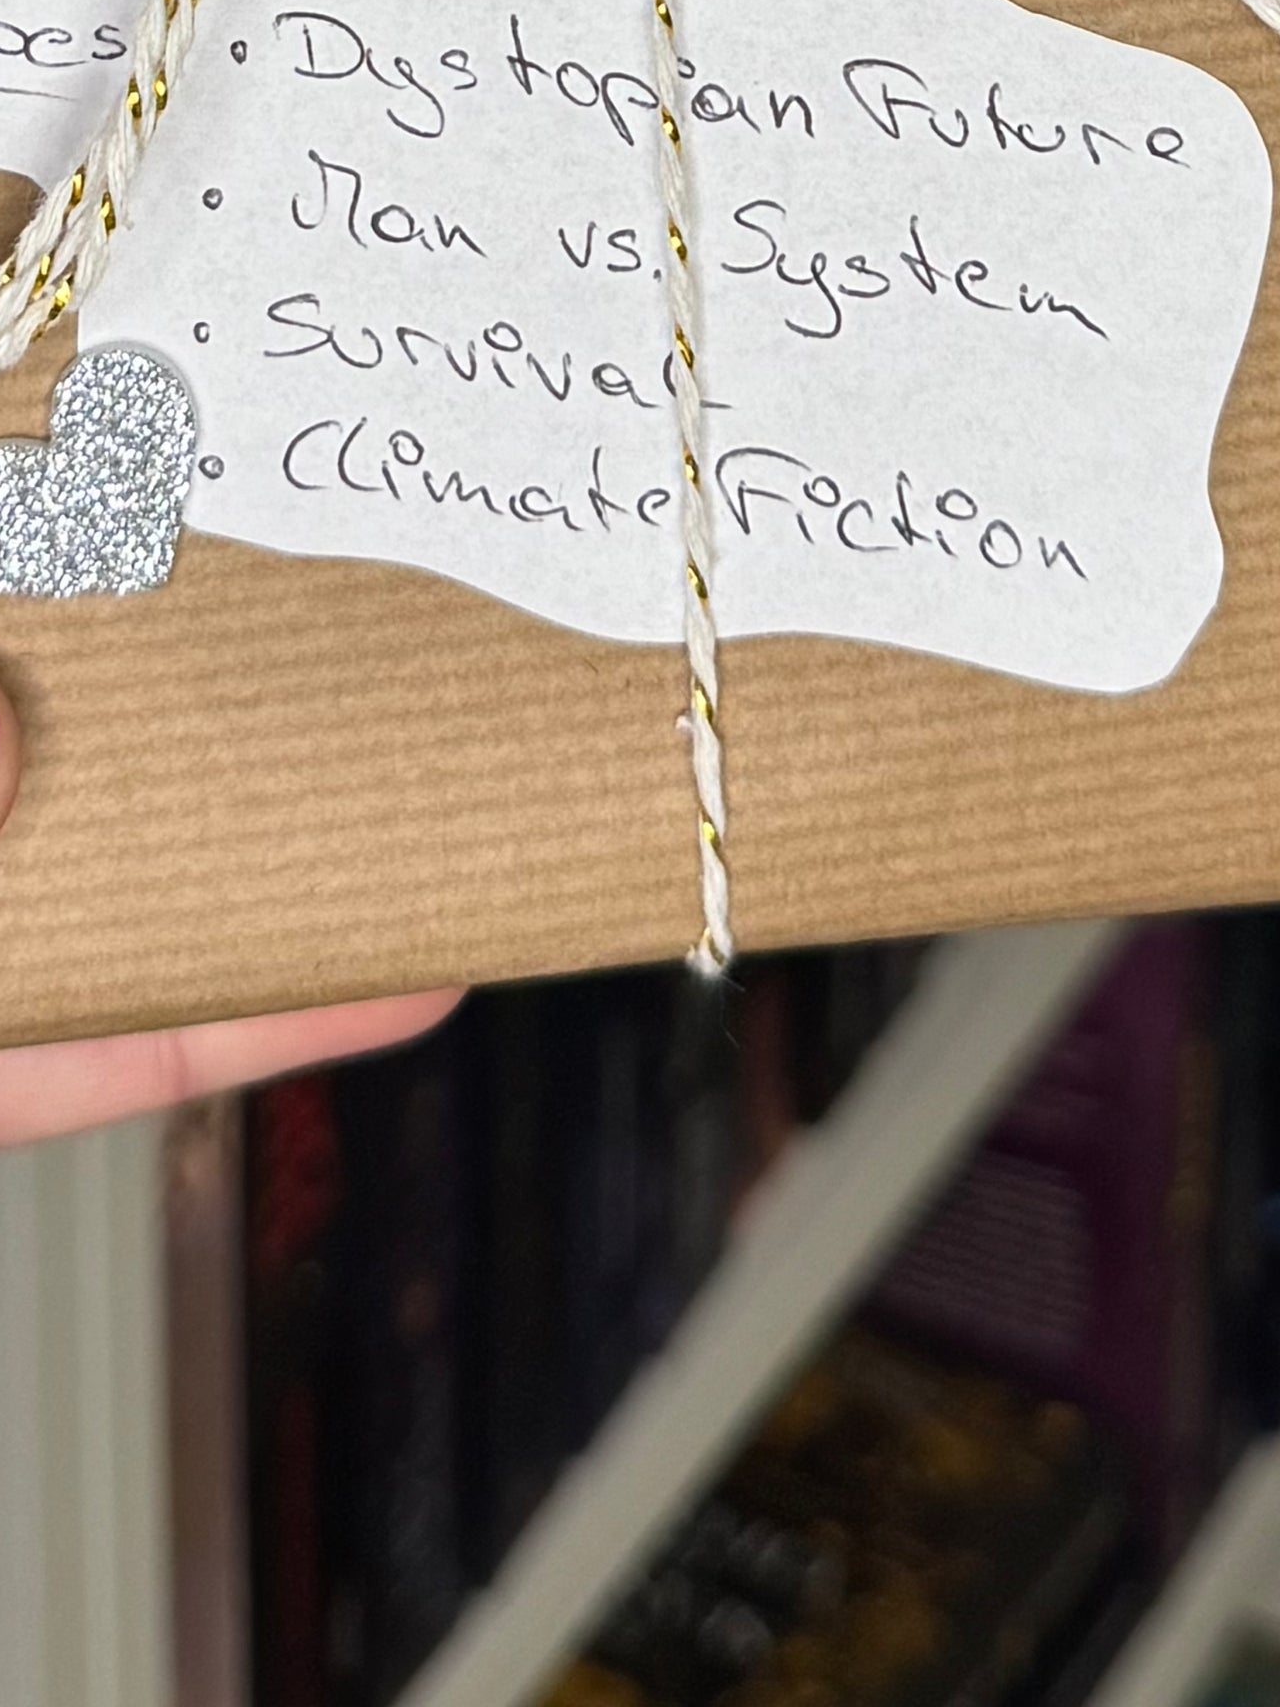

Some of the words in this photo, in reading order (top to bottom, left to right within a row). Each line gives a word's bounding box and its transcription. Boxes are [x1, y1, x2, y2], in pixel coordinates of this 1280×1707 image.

[272, 11, 816, 138] Dystopan
[843, 58, 1193, 169] Future
[290, 149, 488, 258] Man
[720, 199, 1110, 342] System
[263, 292, 732, 409] Survival
[715, 447, 1089, 582] Fiction
